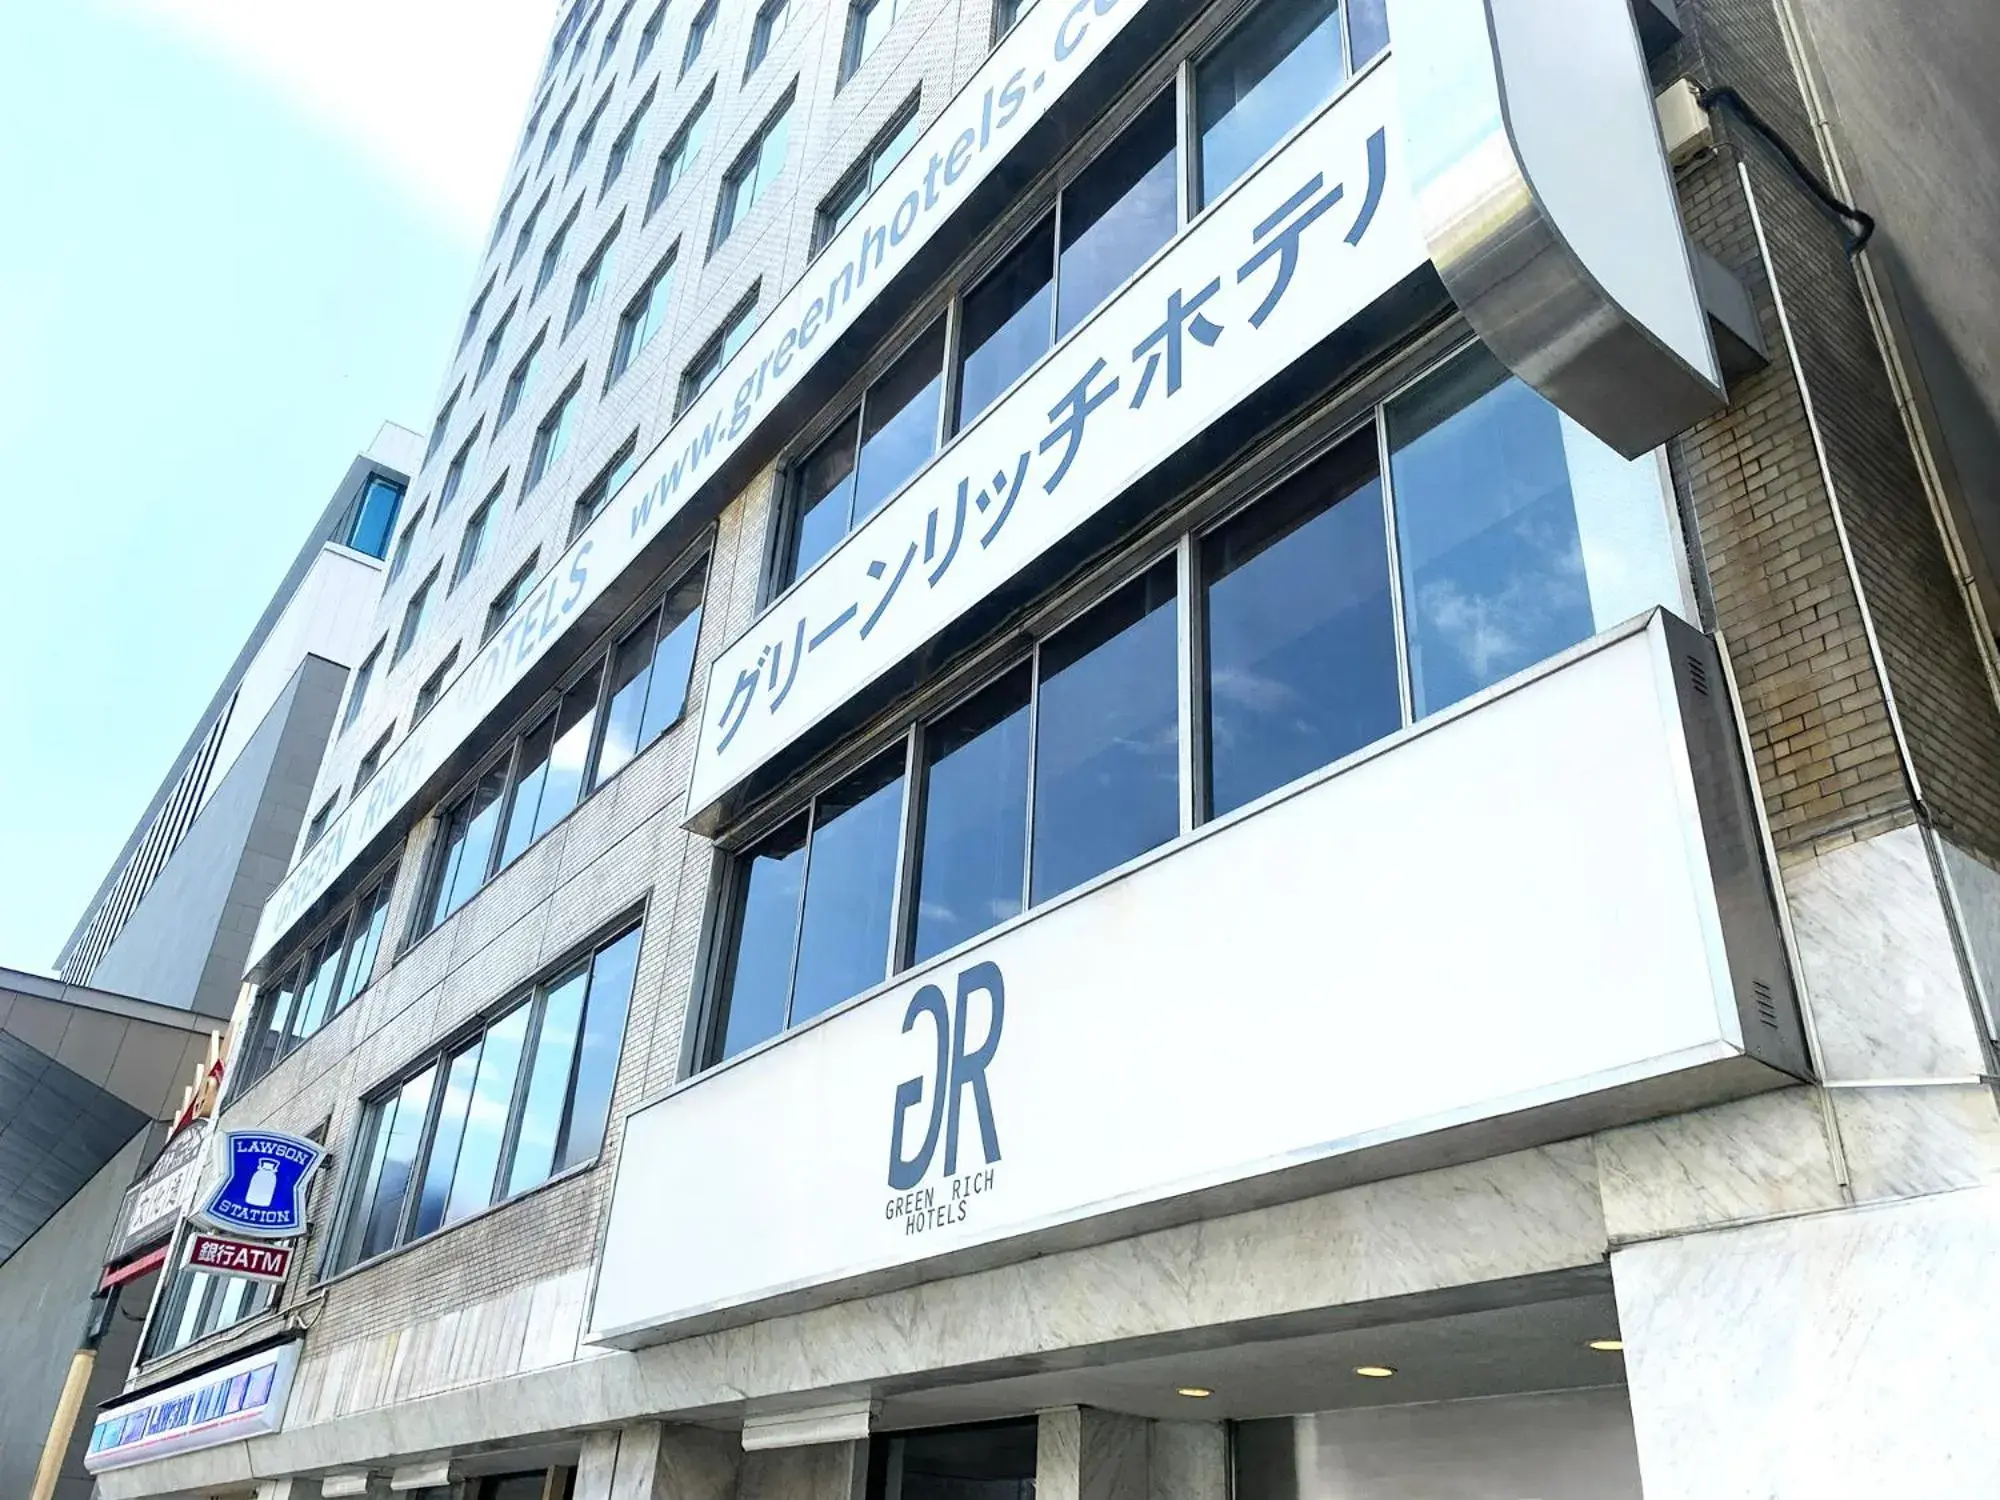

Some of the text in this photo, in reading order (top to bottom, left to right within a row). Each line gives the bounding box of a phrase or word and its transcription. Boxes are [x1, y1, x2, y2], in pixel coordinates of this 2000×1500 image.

[630, 0, 1118, 539] www.greenhotels.c
[236, 1140, 309, 1166] LAWSON
[218, 1199, 290, 1223] STATION
[885, 1168, 995, 1221] GREEN RICH
[905, 1199, 968, 1236] HOTELS
[197, 1241, 283, 1273] 銀行ATM
